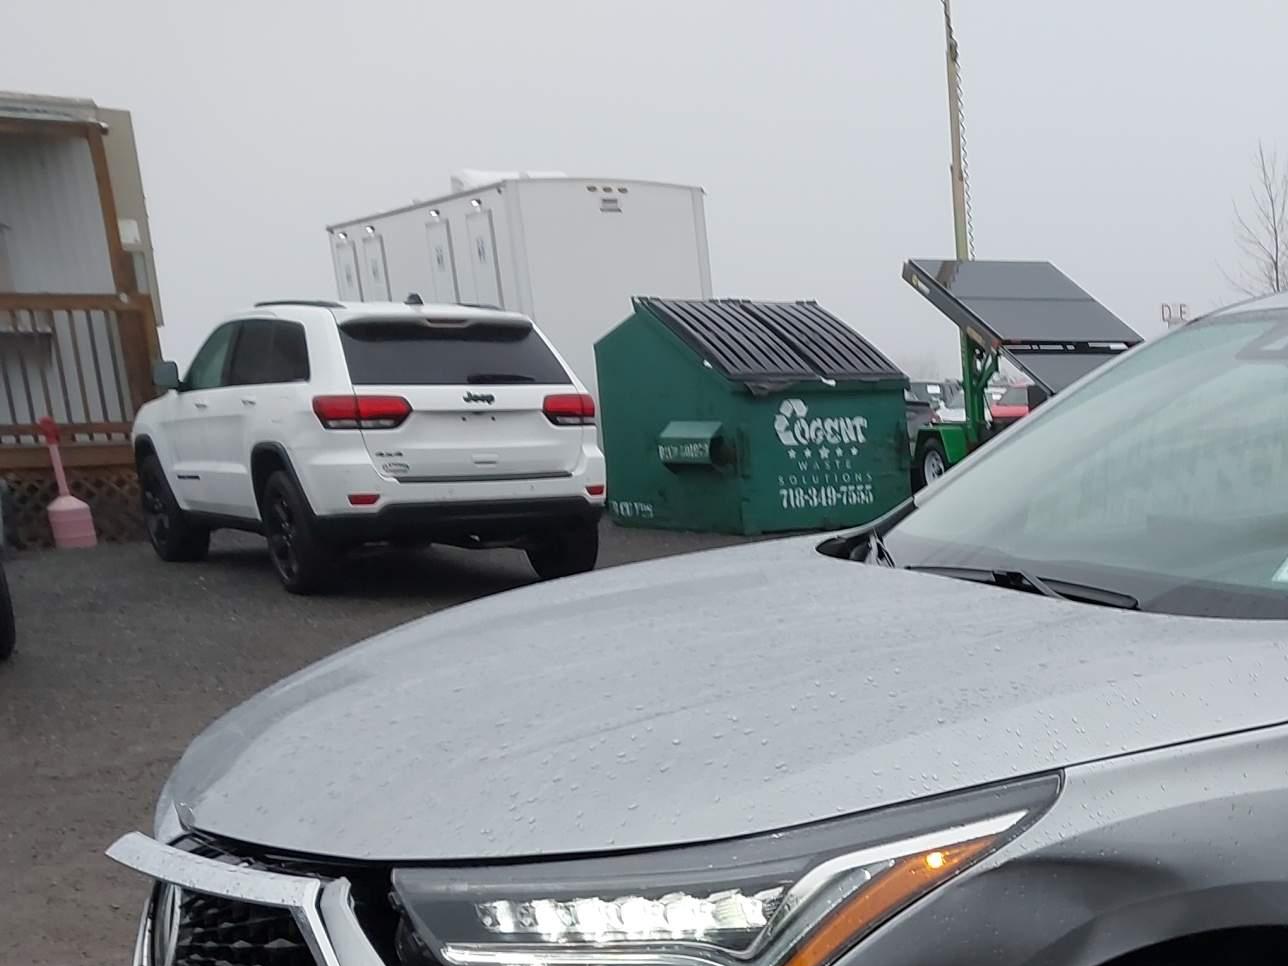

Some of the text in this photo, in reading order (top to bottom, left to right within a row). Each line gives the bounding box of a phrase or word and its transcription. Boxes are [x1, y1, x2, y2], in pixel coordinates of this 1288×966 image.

[462, 391, 495, 405] Jeep
[798, 459, 852, 471] WASTE
[778, 472, 873, 486] SOLUTIONS
[779, 485, 874, 508] 718-349-7555
